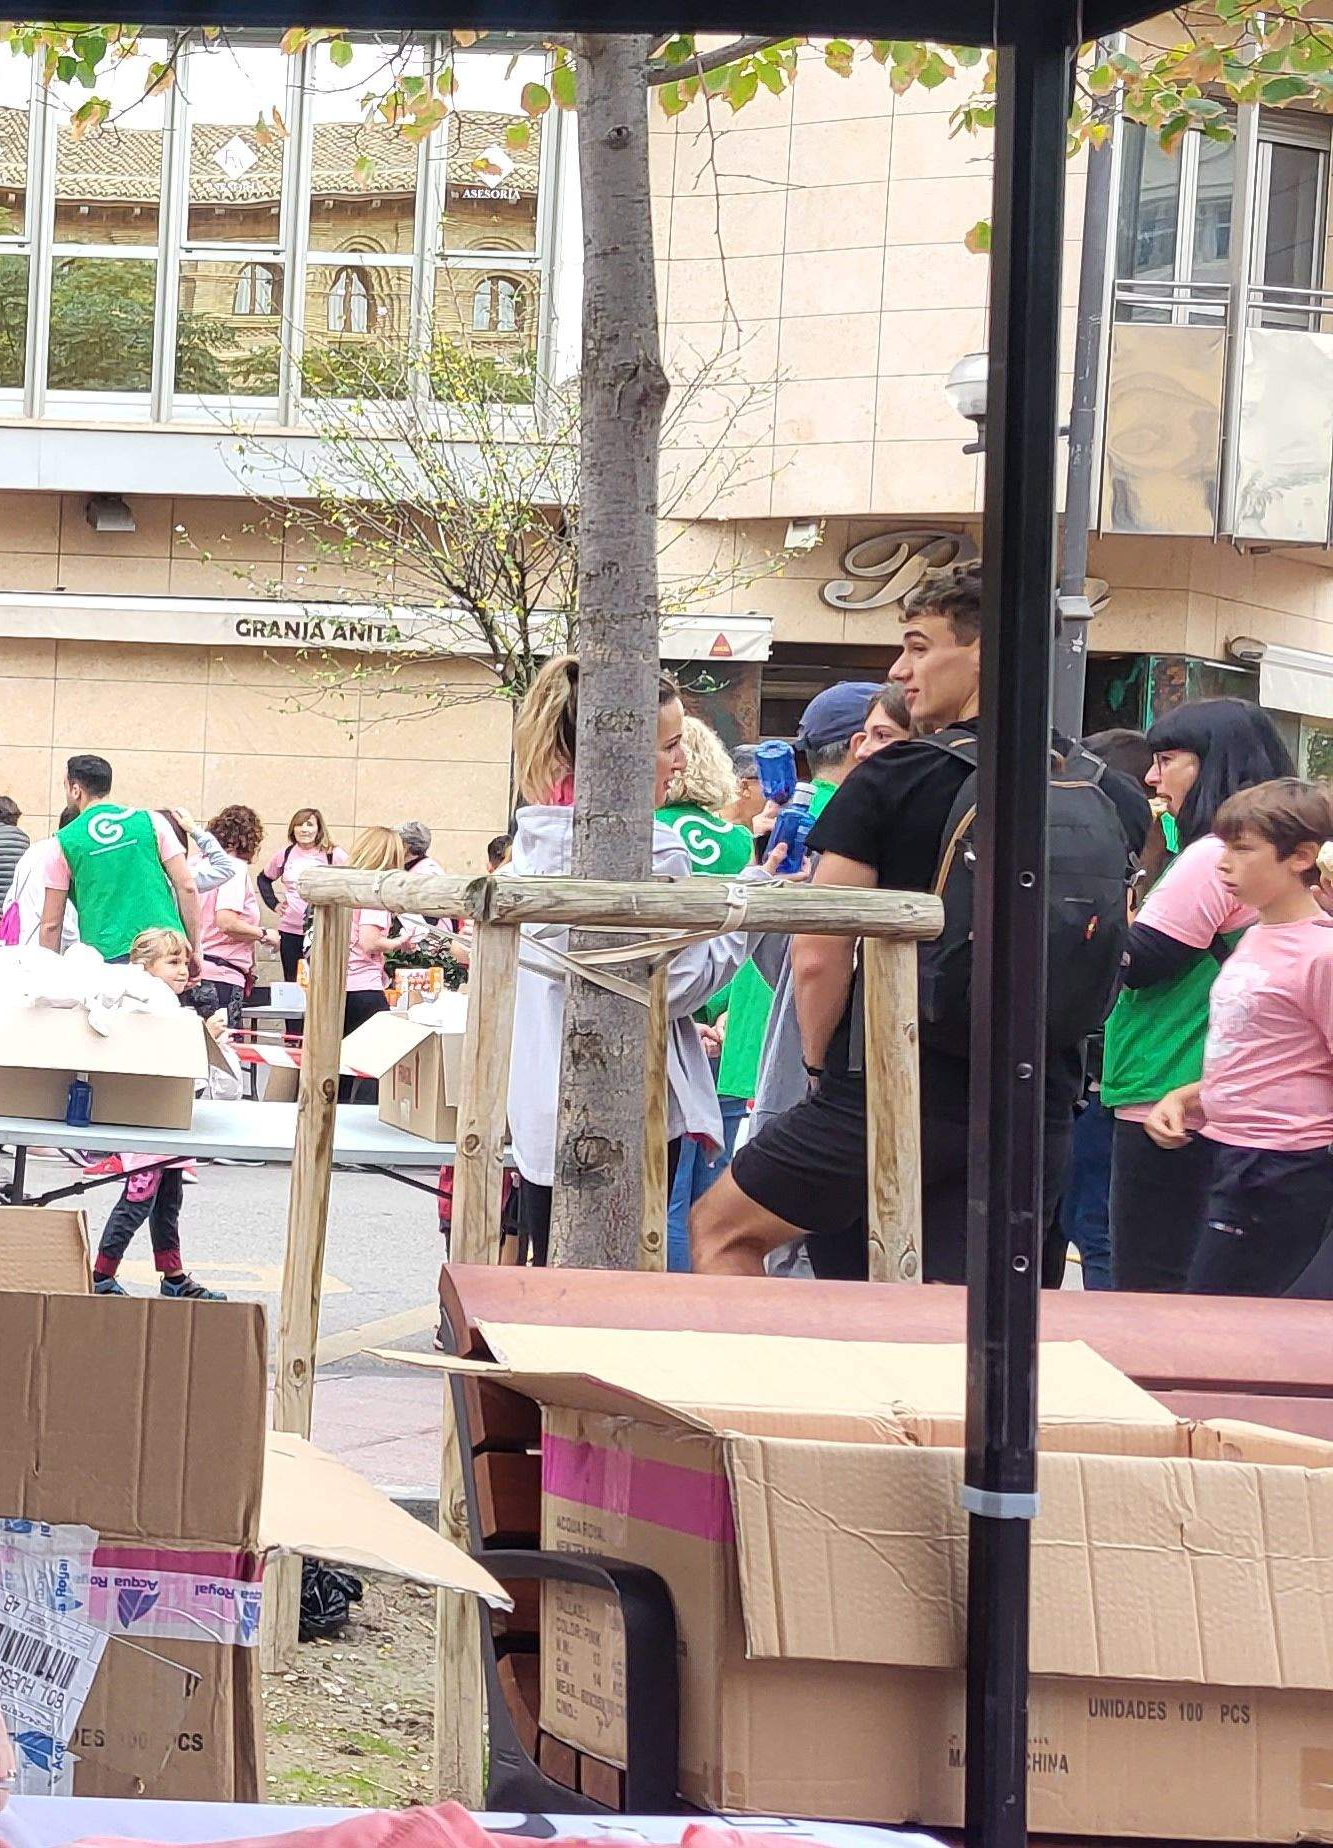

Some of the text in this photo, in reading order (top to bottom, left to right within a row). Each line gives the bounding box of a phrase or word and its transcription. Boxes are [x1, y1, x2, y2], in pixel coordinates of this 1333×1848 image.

[235, 619, 401, 642] GRANJA ANITA
[113, 1577, 159, 1591] Acqua
[194, 1584, 235, 1600] Royal
[1088, 1697, 1251, 1723] UNIDADES 100 PCS
